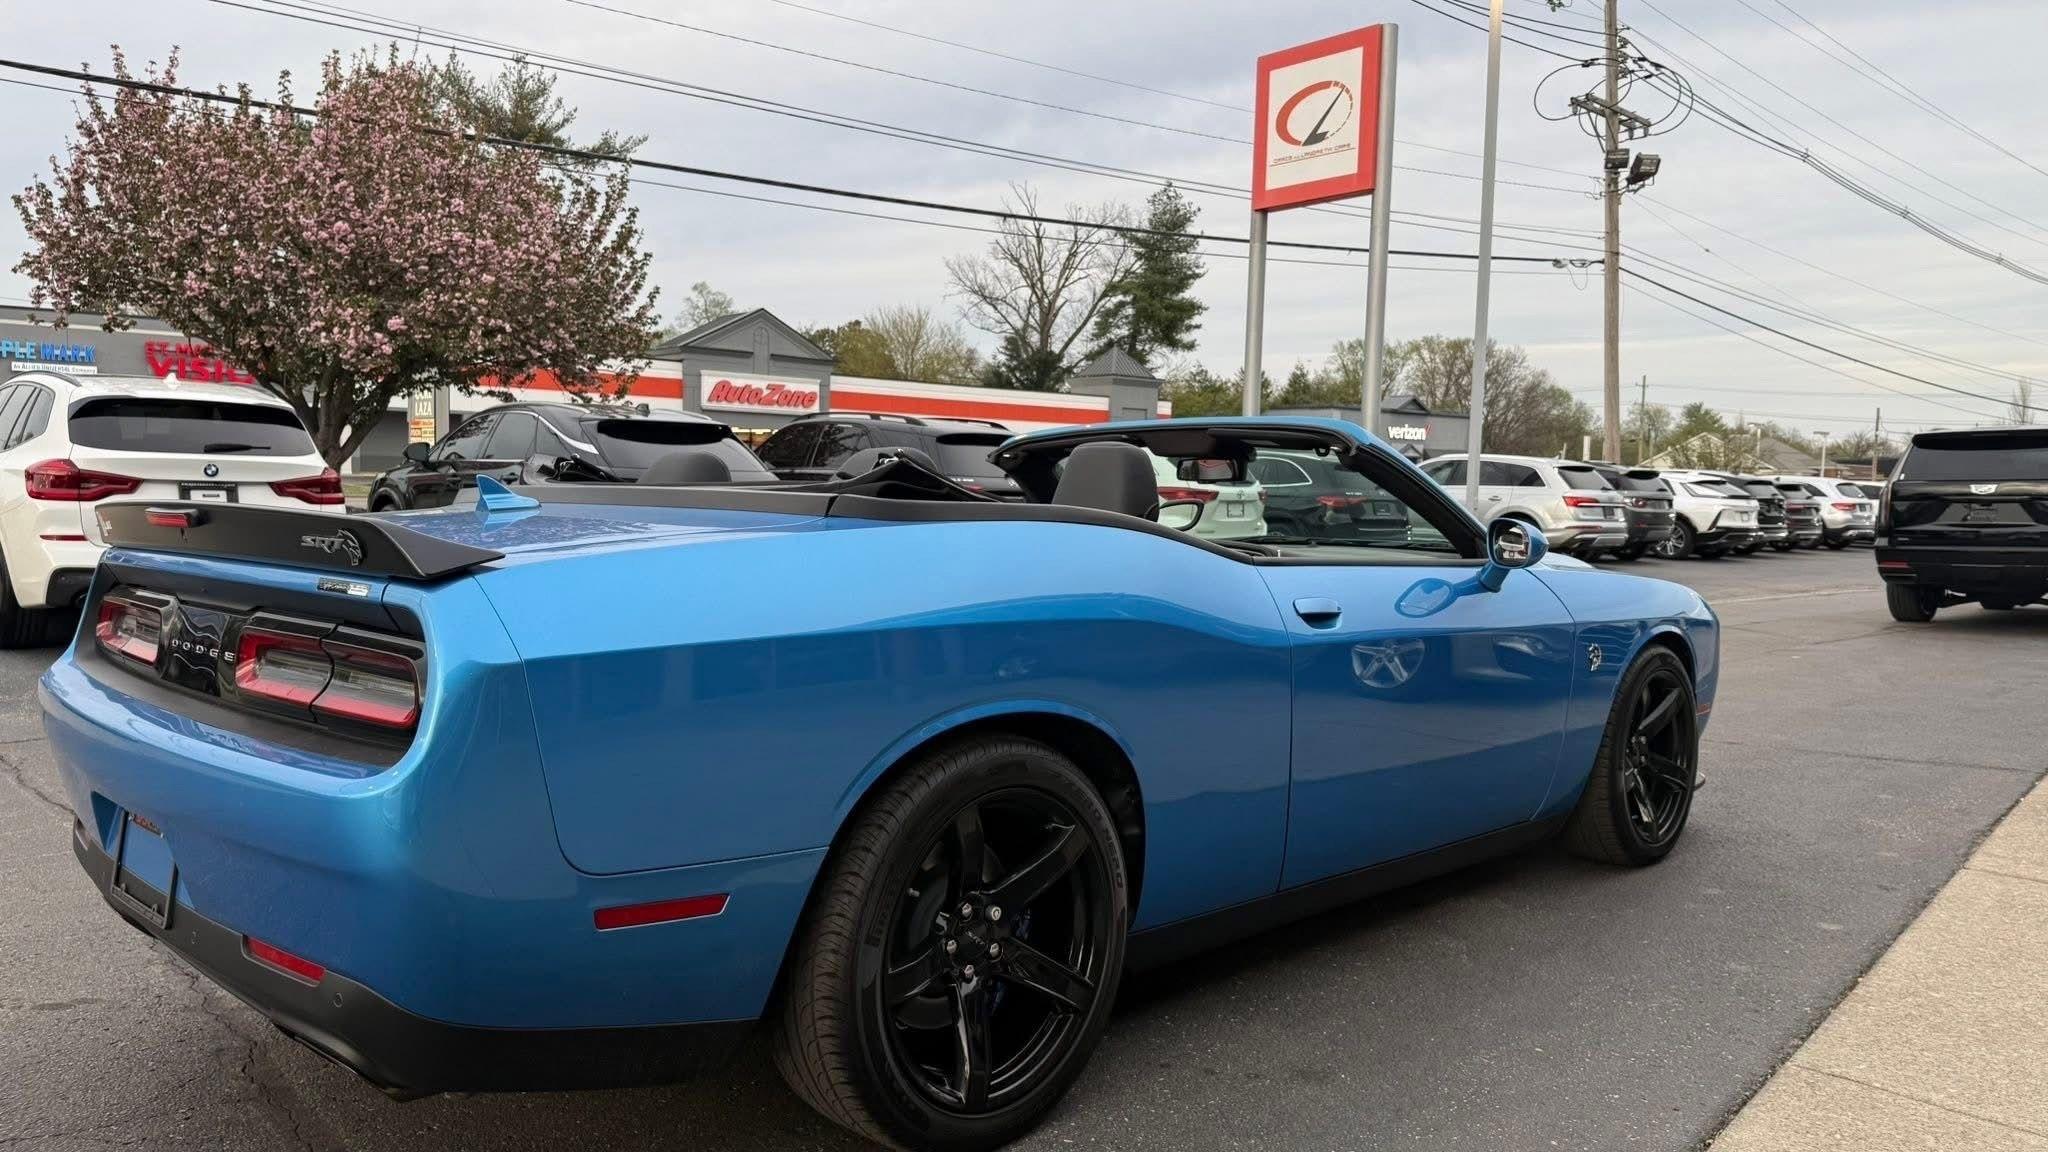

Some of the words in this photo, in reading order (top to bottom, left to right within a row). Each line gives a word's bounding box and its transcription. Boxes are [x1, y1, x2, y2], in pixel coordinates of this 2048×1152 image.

[0, 339, 36, 359] PLE
[41, 342, 96, 362] MARK
[708, 380, 818, 408] AutoZone
[1387, 424, 1426, 440] verizon
[301, 535, 345, 553] SRT
[172, 639, 235, 662] DODGE
